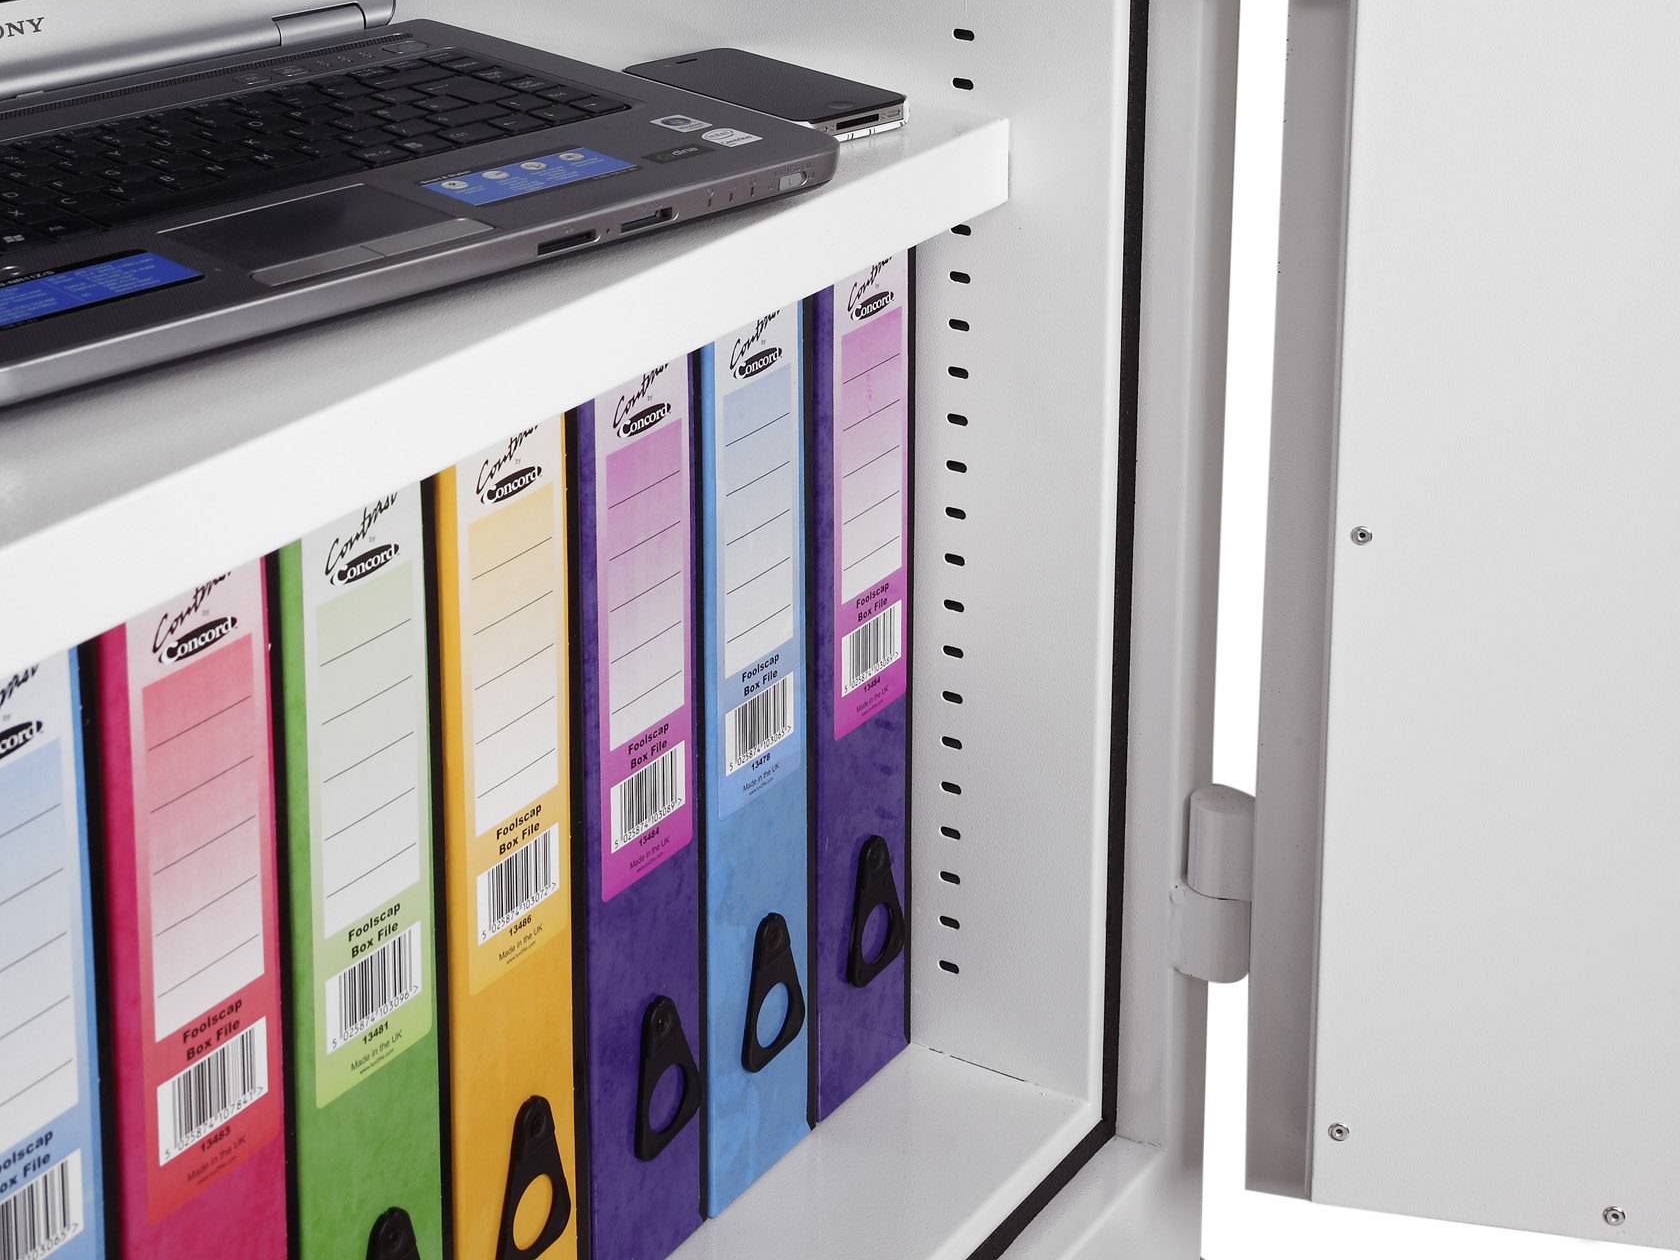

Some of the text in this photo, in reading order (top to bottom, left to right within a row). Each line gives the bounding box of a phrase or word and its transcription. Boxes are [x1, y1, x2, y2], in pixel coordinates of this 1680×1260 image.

[852, 291, 893, 320] Concord
[735, 346, 780, 379] Concord
[619, 402, 668, 438] Concord
[482, 466, 538, 504] Concord
[332, 543, 396, 585] Concord
[856, 582, 890, 609] Foolscap
[858, 596, 888, 623] Box File
[160, 616, 232, 664] Concord
[742, 653, 780, 683] Foolscap
[744, 669, 778, 697] Box File
[856, 700, 869, 713] Made
[881, 685, 889, 696] UK
[628, 723, 669, 755] Foolscap
[630, 739, 668, 770] Box File
[743, 777, 757, 792] Made
[772, 762, 780, 774] UK
[496, 804, 542, 840] Foolscap
[499, 822, 540, 856] Box File
[630, 854, 645, 870] Made
[660, 836, 670, 849] UK
[348, 903, 401, 942] Foolscap
[491, 908, 519, 933] 025874
[509, 915, 532, 937] 13486
[351, 921, 398, 959] Box File
[498, 944, 515, 961] Made
[533, 923, 543, 937] UK
[183, 999, 242, 1044] Foolscap
[343, 1015, 376, 1042] 025874
[379, 991, 410, 1017] 103096
[363, 1021, 389, 1045] 13481
[186, 1019, 240, 1061] Box File
[350, 1053, 370, 1072] Made
[392, 1029, 403, 1044] UK
[0, 1131, 53, 1172] olscap
[23, 1153, 51, 1178] File
[188, 1161, 210, 1182] Made
[234, 1136, 246, 1151] UK
